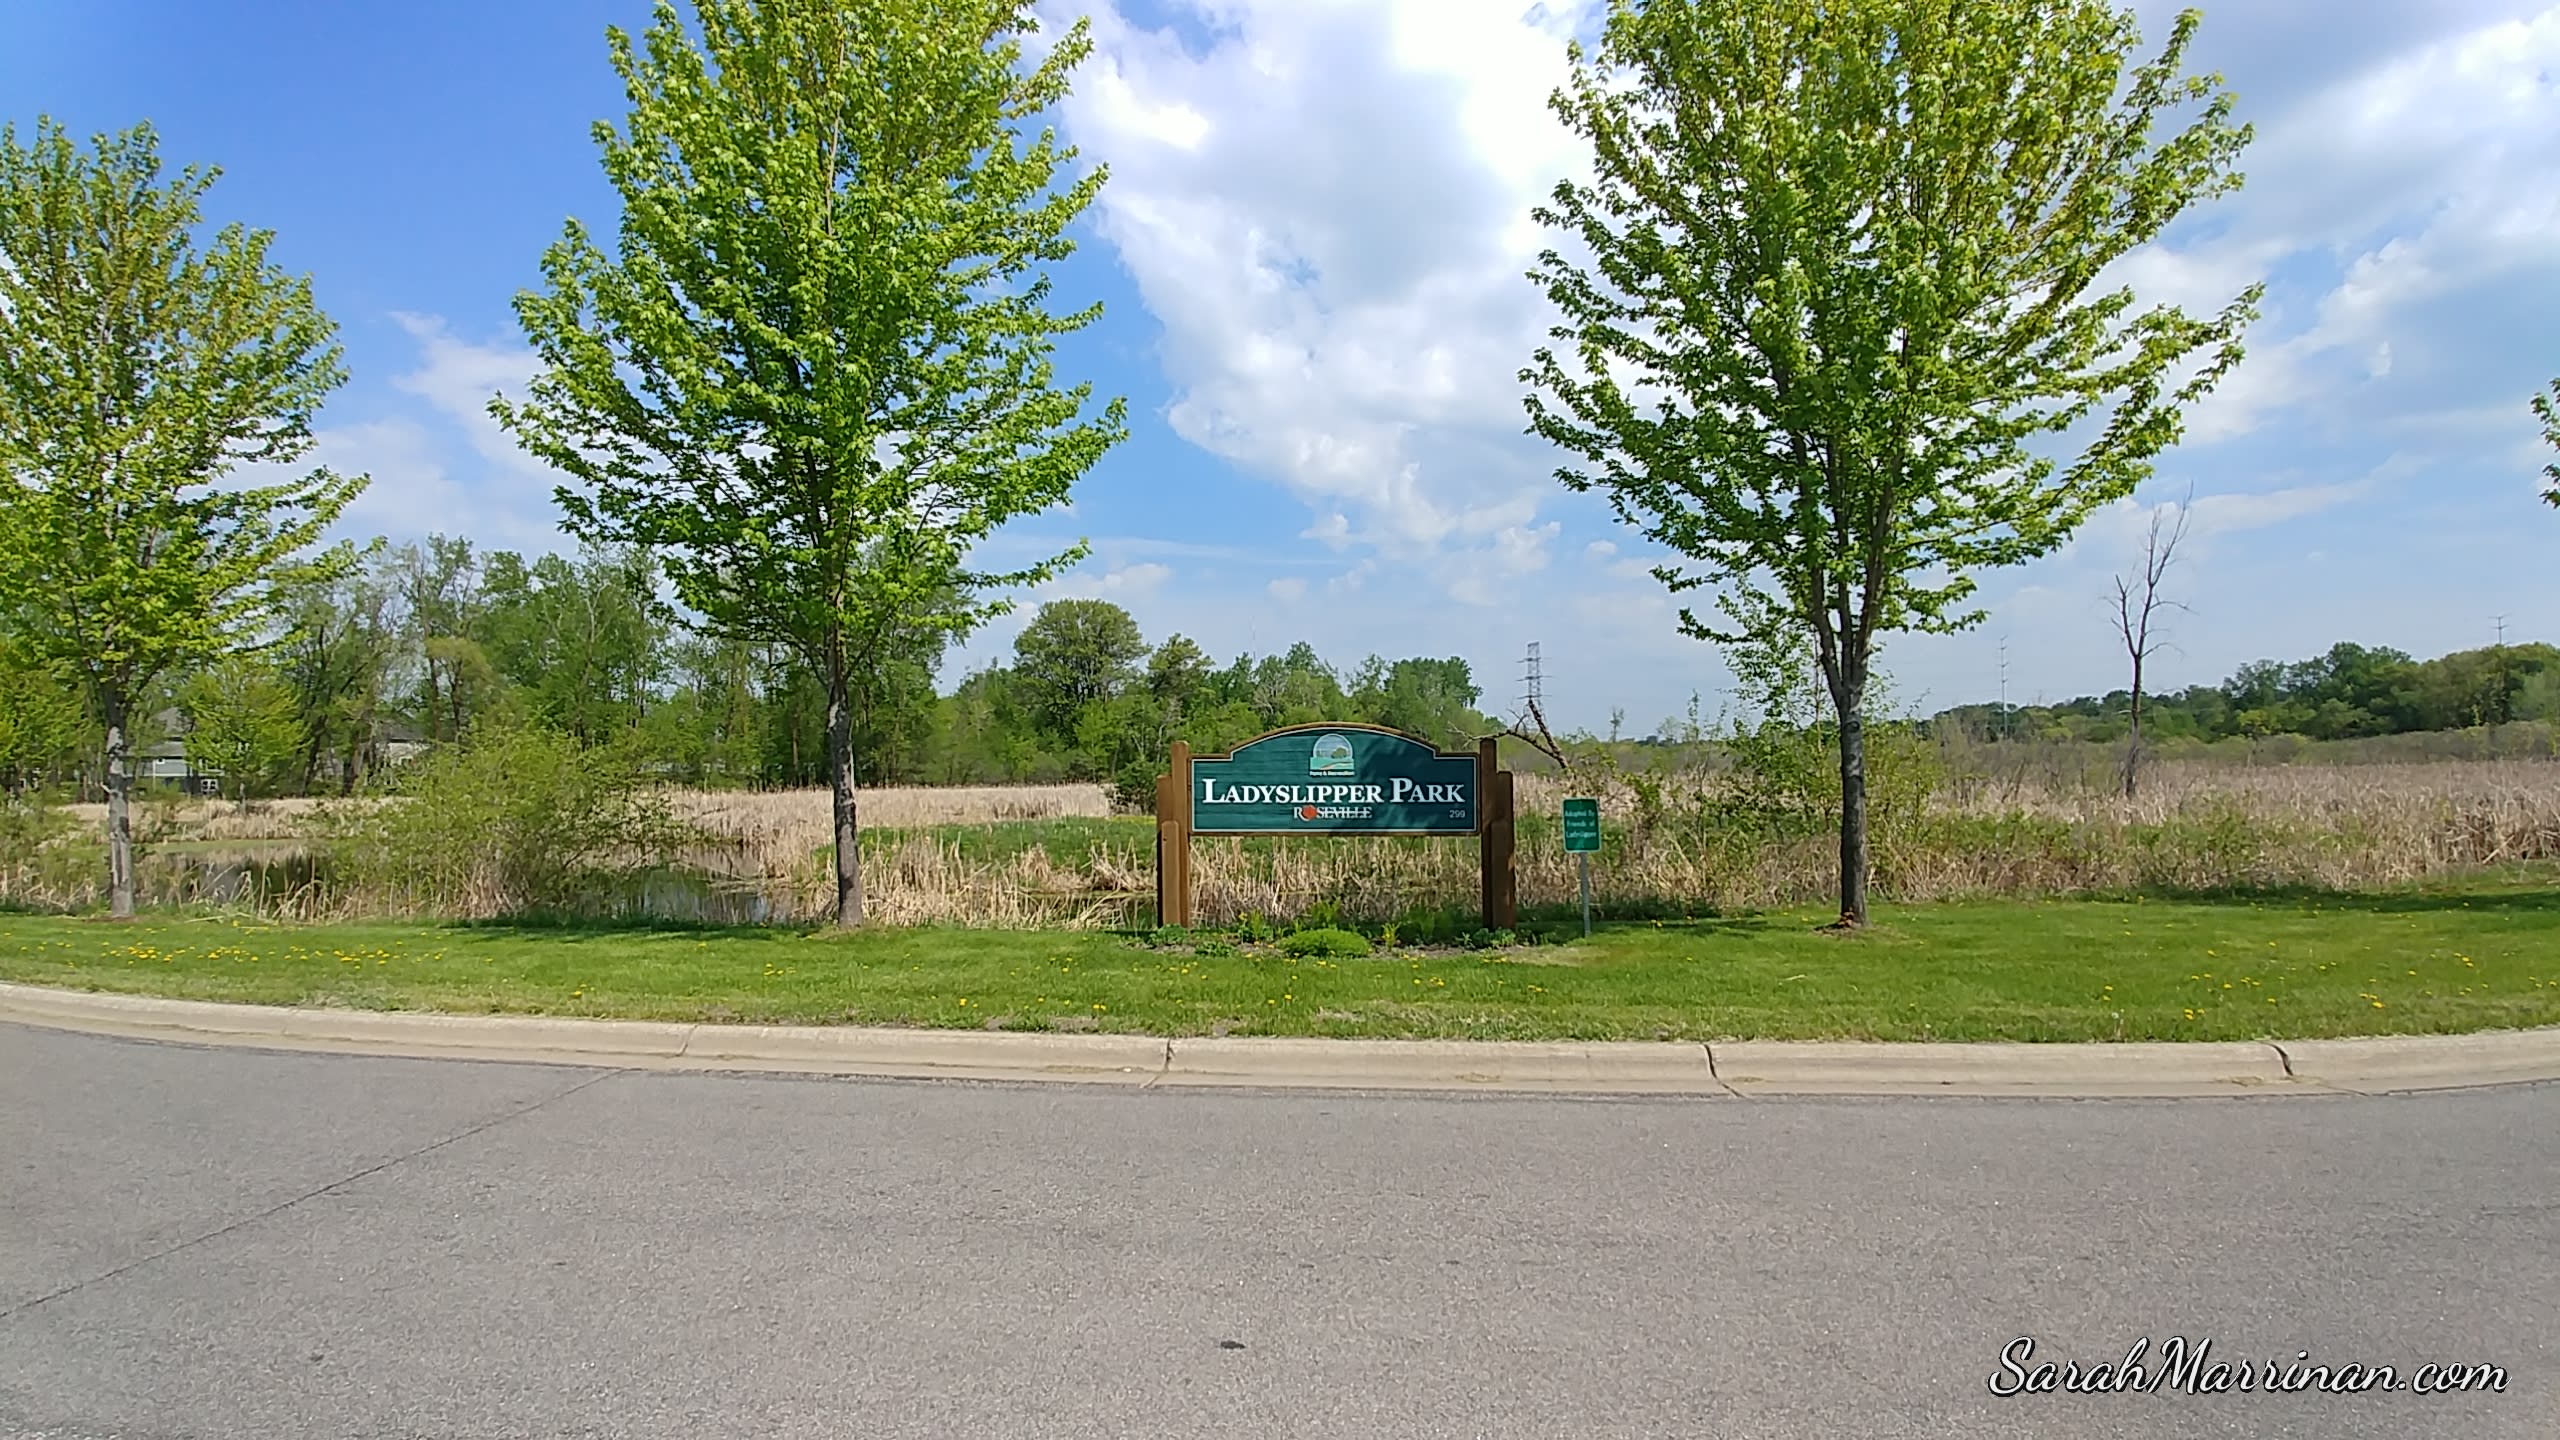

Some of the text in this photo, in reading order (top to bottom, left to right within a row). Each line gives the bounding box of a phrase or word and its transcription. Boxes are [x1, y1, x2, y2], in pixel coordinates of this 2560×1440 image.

[1201, 777, 1465, 804] LADYSLIPPER PARK
[1293, 804, 1373, 821] ROSEVILLE
